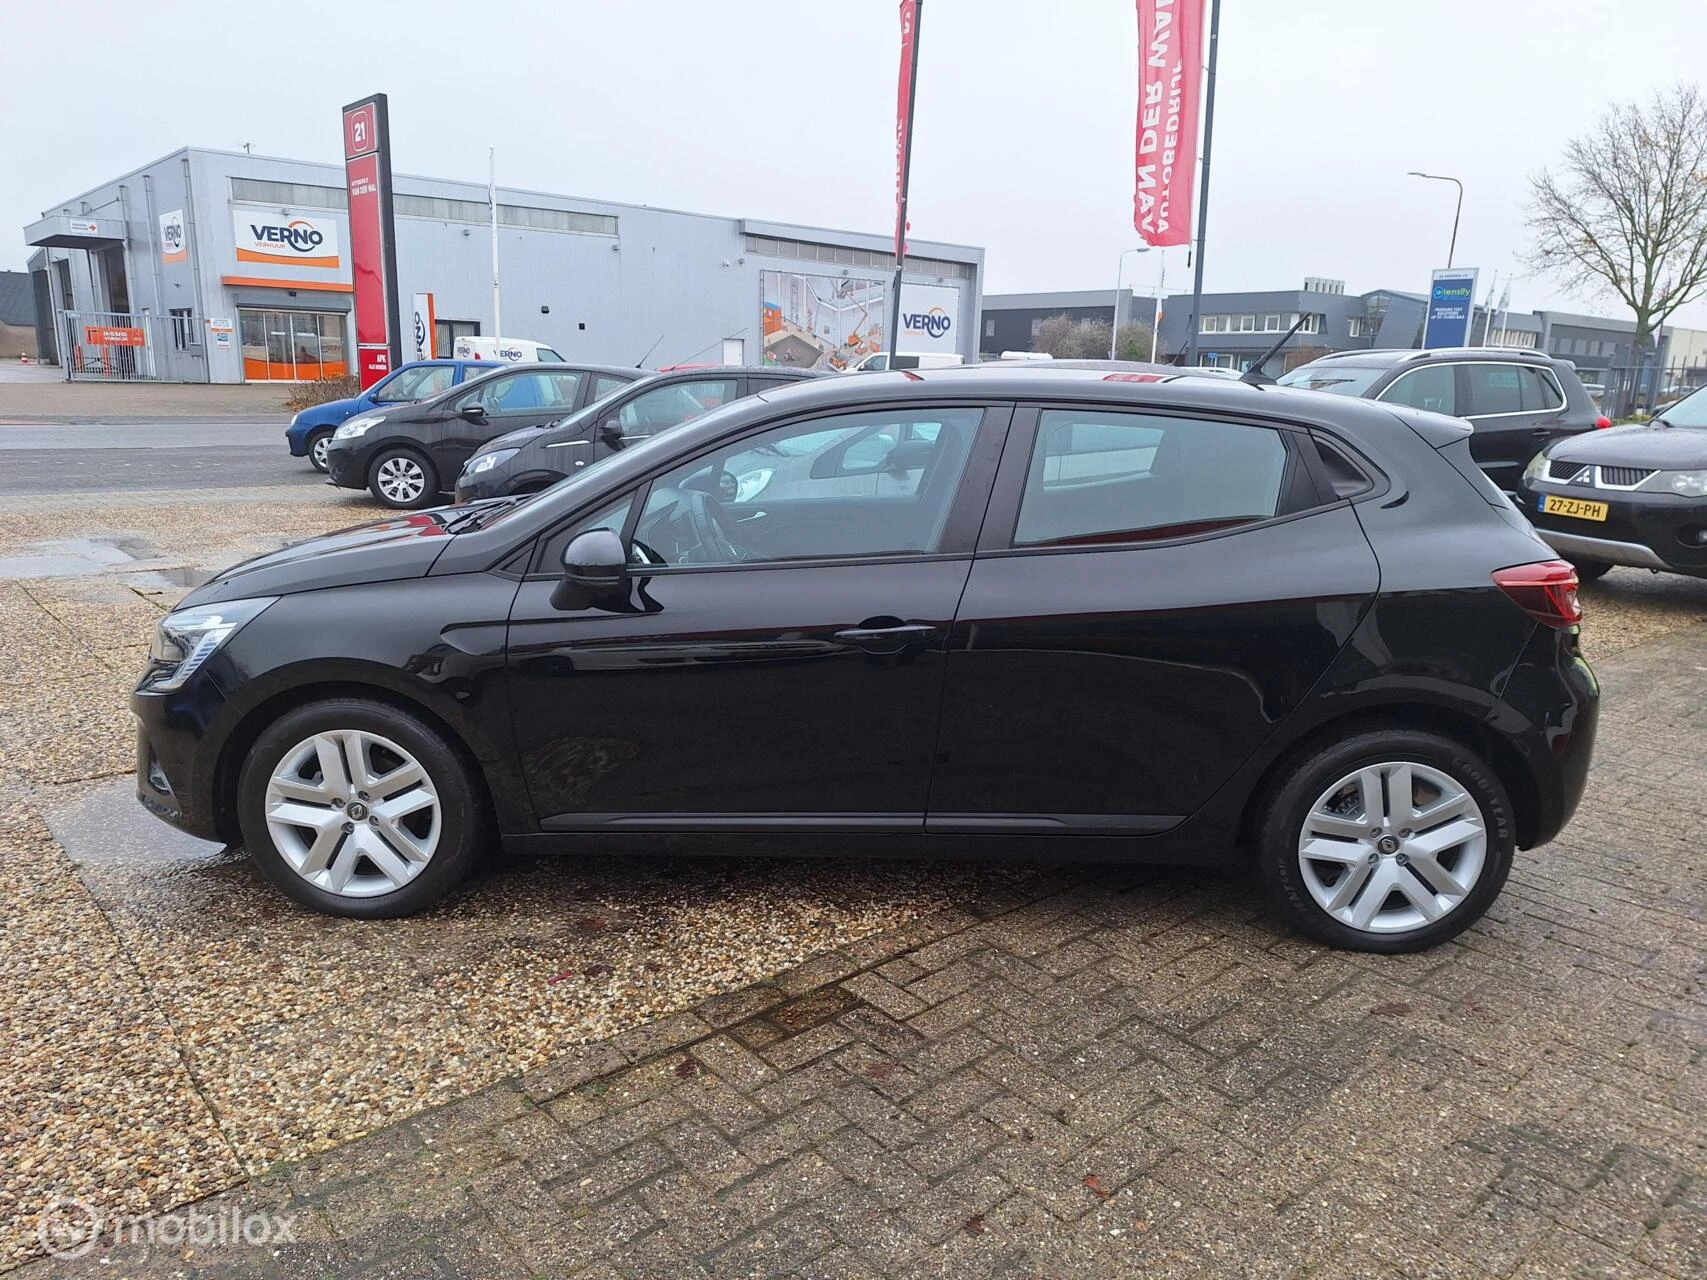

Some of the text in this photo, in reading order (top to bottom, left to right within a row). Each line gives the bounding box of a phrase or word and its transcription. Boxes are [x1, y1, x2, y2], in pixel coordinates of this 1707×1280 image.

[354, 121, 366, 142] 21
[250, 224, 323, 252] VERNO
[254, 241, 286, 249] VERHUUR
[903, 313, 951, 338] VERNO
[1549, 499, 1601, 518] 27-ZJ-PH
